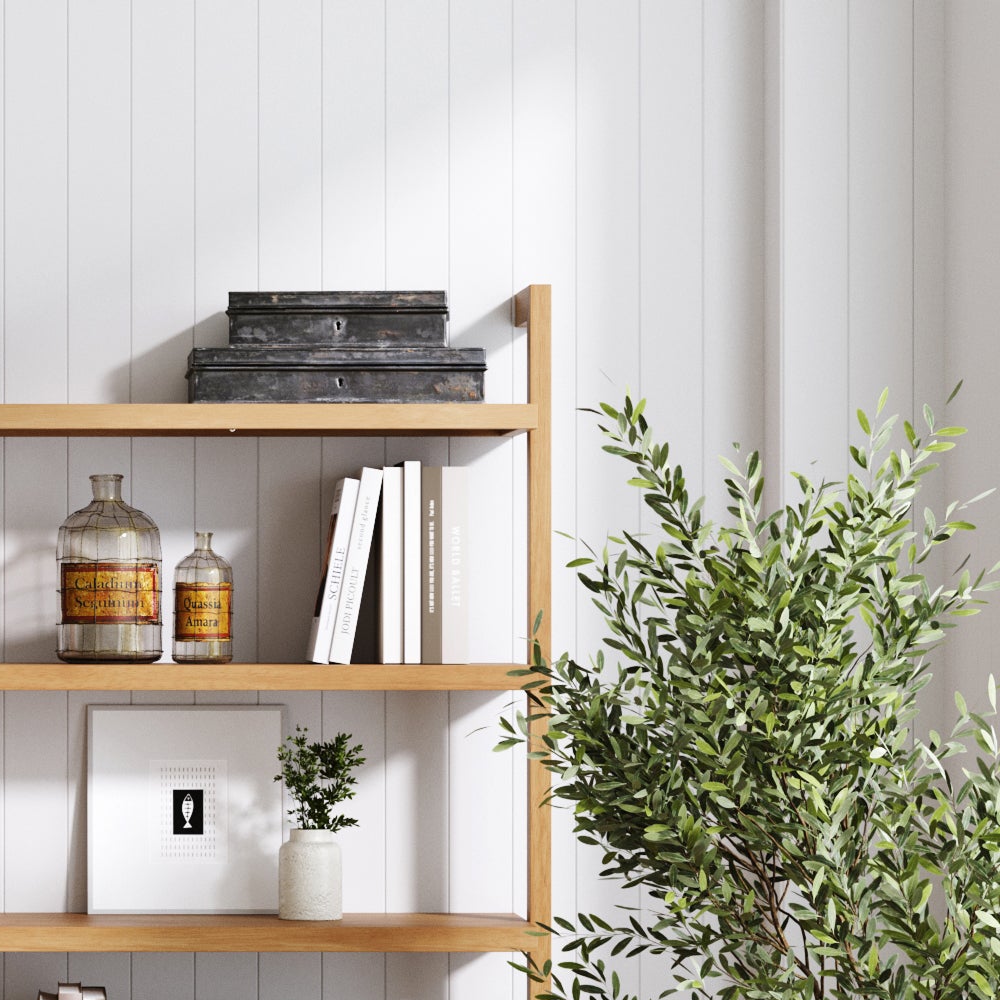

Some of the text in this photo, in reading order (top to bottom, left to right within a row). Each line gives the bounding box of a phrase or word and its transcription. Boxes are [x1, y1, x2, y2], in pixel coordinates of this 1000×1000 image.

[357, 523, 366, 550] second
[329, 546, 346, 600] SCHIELE
[451, 526, 461, 608] WORLD BALLET
[183, 597, 222, 611] Quassia
[341, 567, 360, 635] JODI PICOULT
[185, 616, 219, 628] Amara
